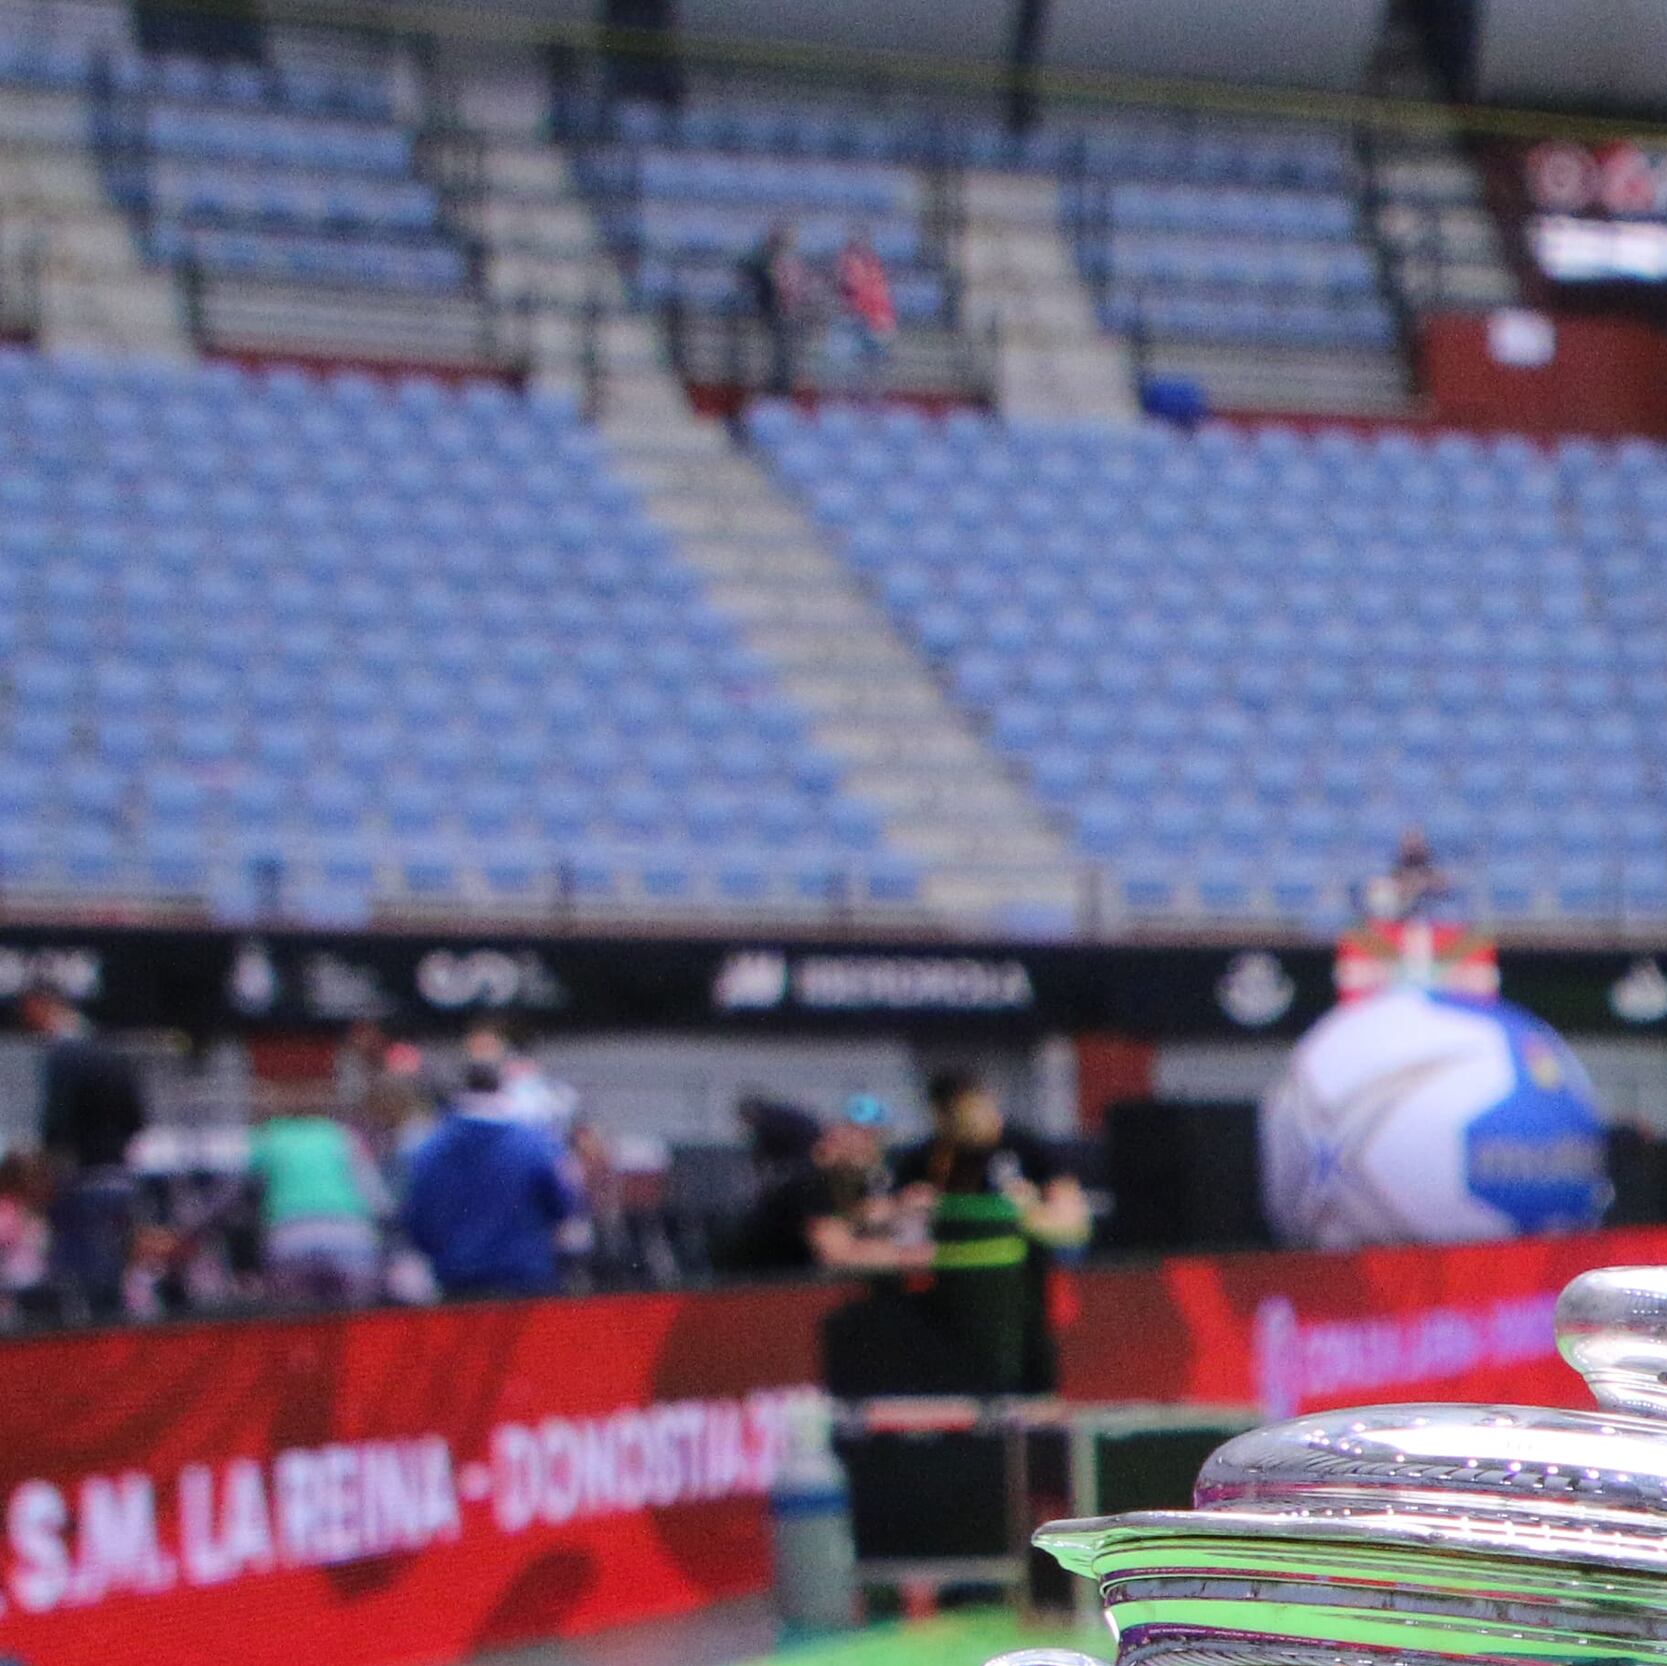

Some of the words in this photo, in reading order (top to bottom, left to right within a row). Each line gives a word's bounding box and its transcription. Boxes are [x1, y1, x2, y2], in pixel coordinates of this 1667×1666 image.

[179, 1460, 272, 1587] LA
[274, 1434, 461, 1566] REINA
[490, 1396, 745, 1534] DONOSTIA
